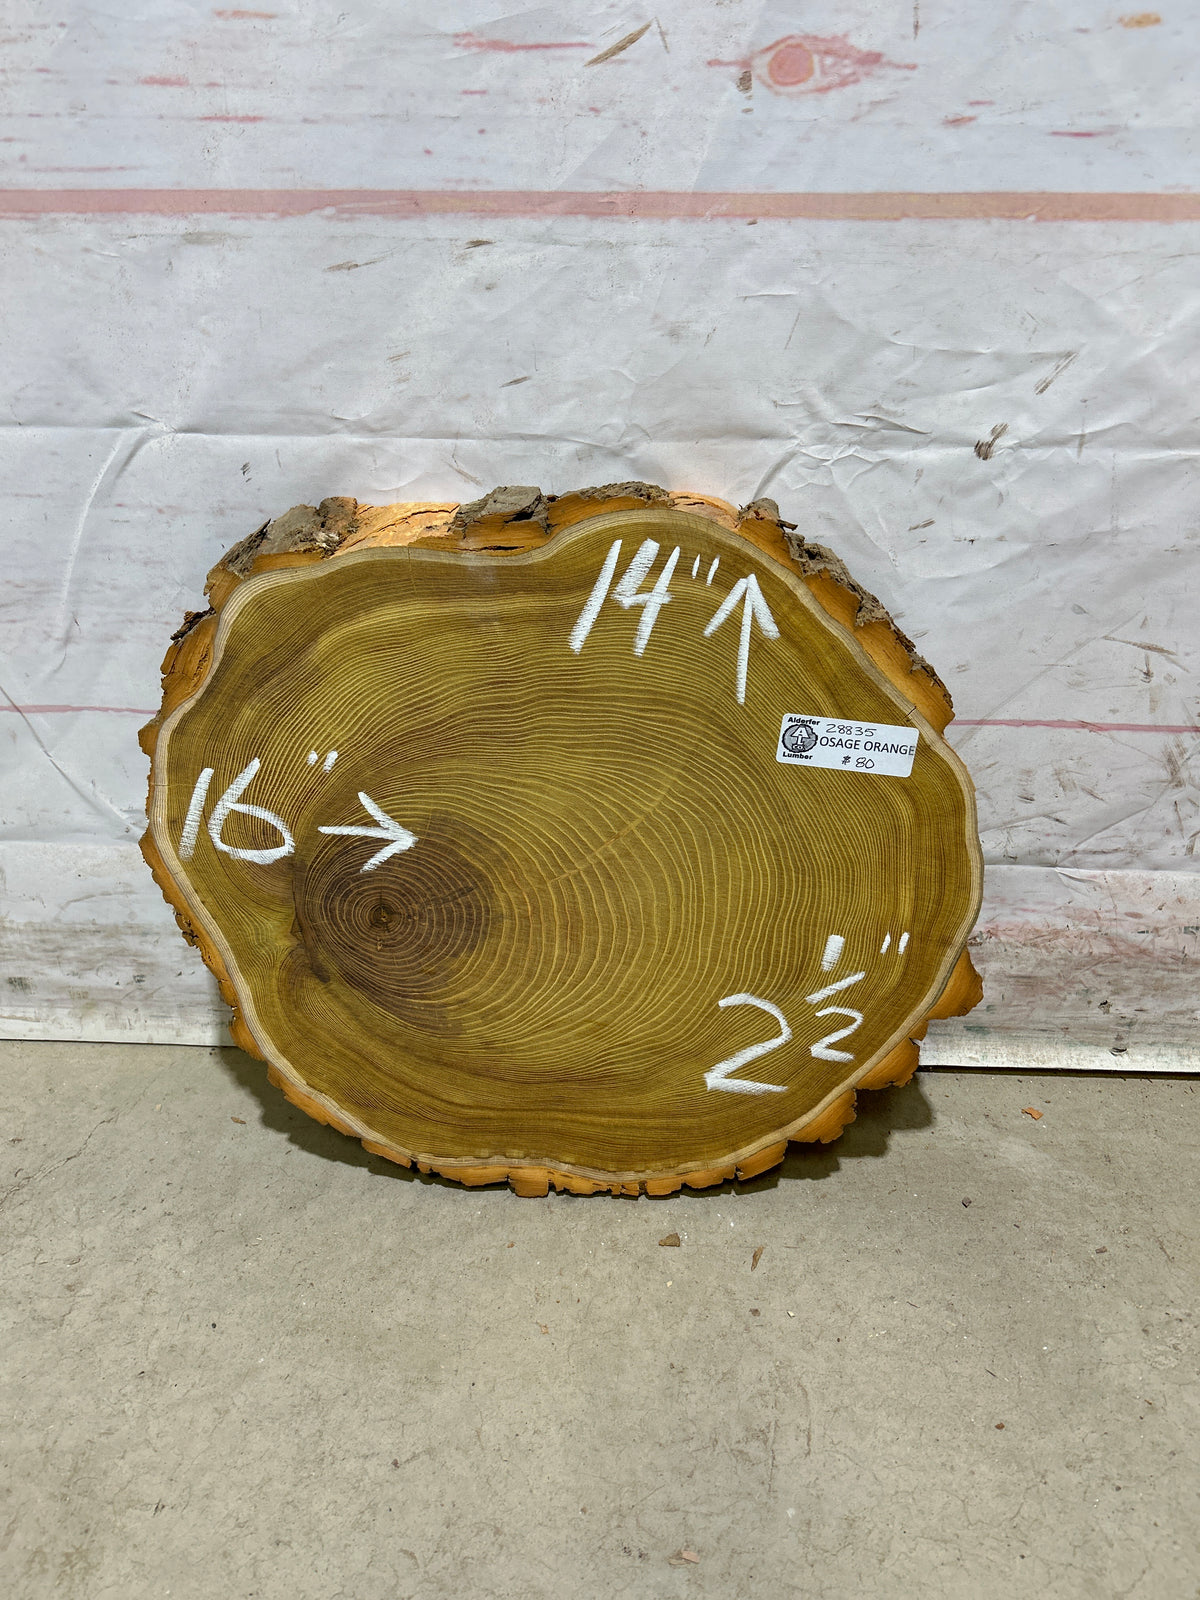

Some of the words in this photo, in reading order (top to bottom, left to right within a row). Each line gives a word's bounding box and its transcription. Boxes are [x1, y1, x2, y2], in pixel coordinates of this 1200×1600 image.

[787, 716, 821, 726] Alderfer
[825, 723, 877, 737] 28835
[819, 736, 861, 751] OSAGE
[863, 740, 916, 756] ORANGE
[782, 751, 813, 760] Lumber
